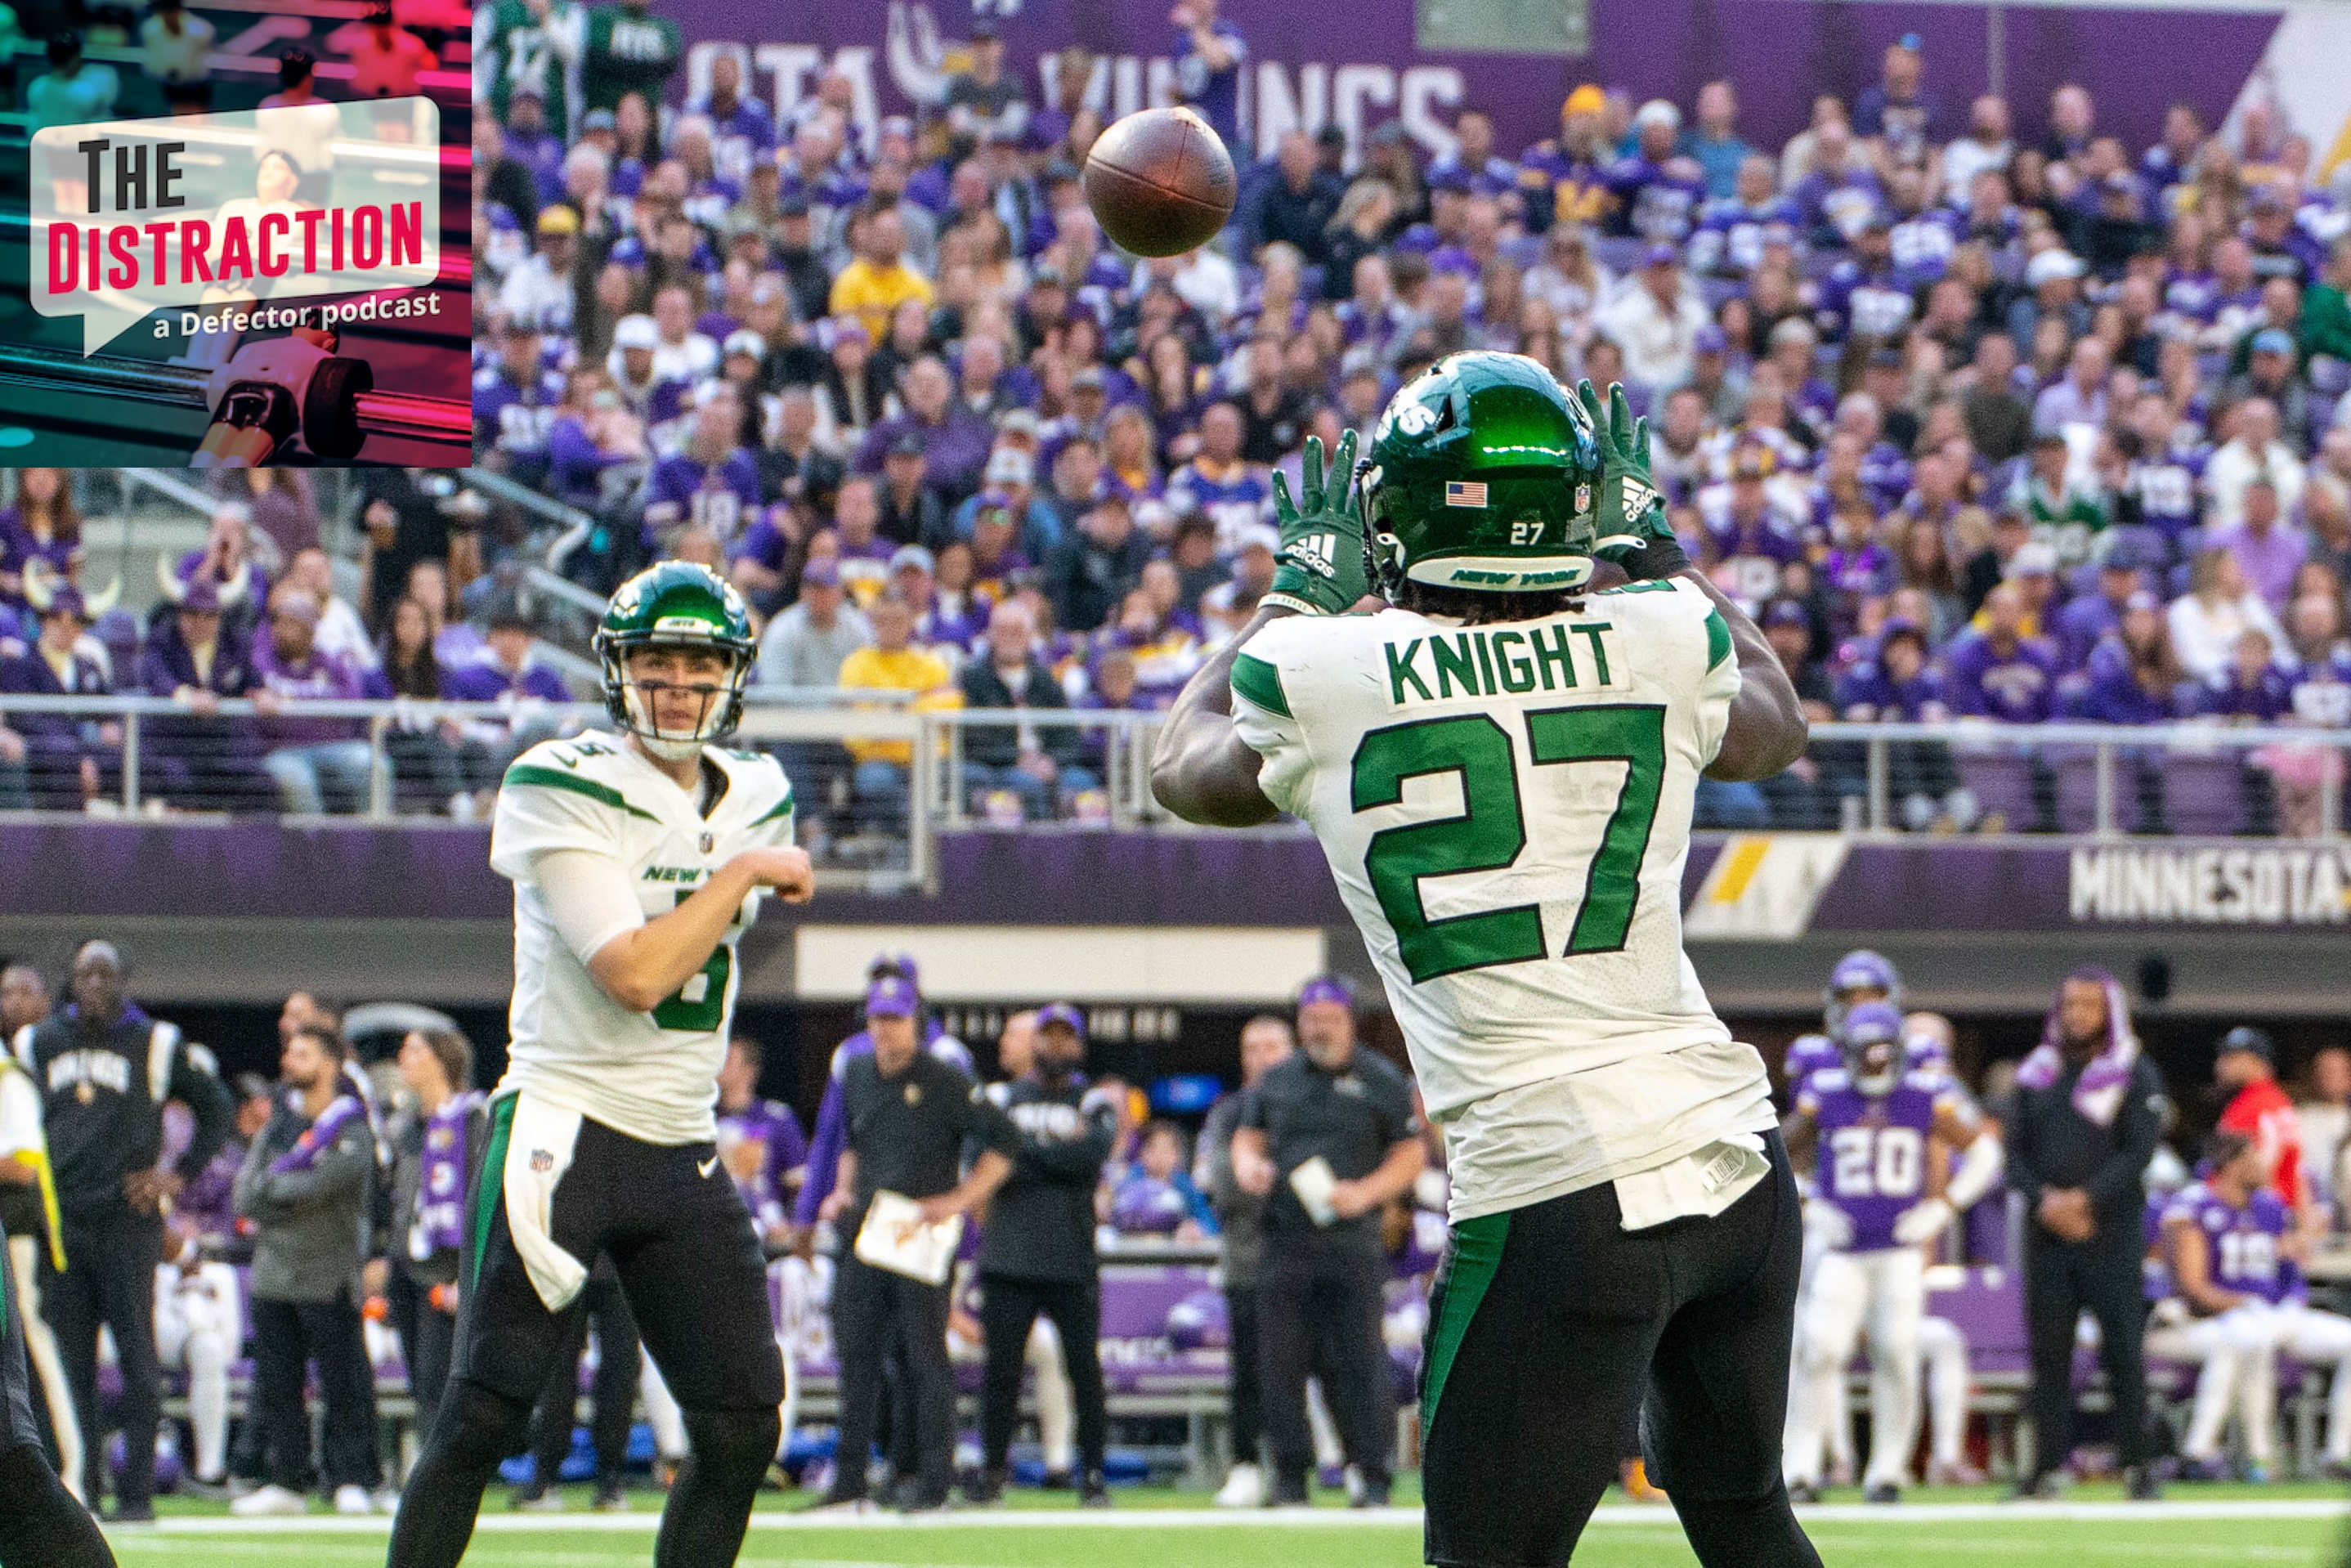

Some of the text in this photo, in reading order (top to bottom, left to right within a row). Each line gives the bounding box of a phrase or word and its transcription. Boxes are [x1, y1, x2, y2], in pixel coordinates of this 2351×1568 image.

[1511, 522, 1545, 545] 27
[1449, 569, 1581, 586] NEW YORK
[1384, 622, 1614, 705] KNIGHT
[1350, 704, 1668, 985] 27
[641, 866, 701, 882] NEW
[1831, 1126, 1922, 1197] 20
